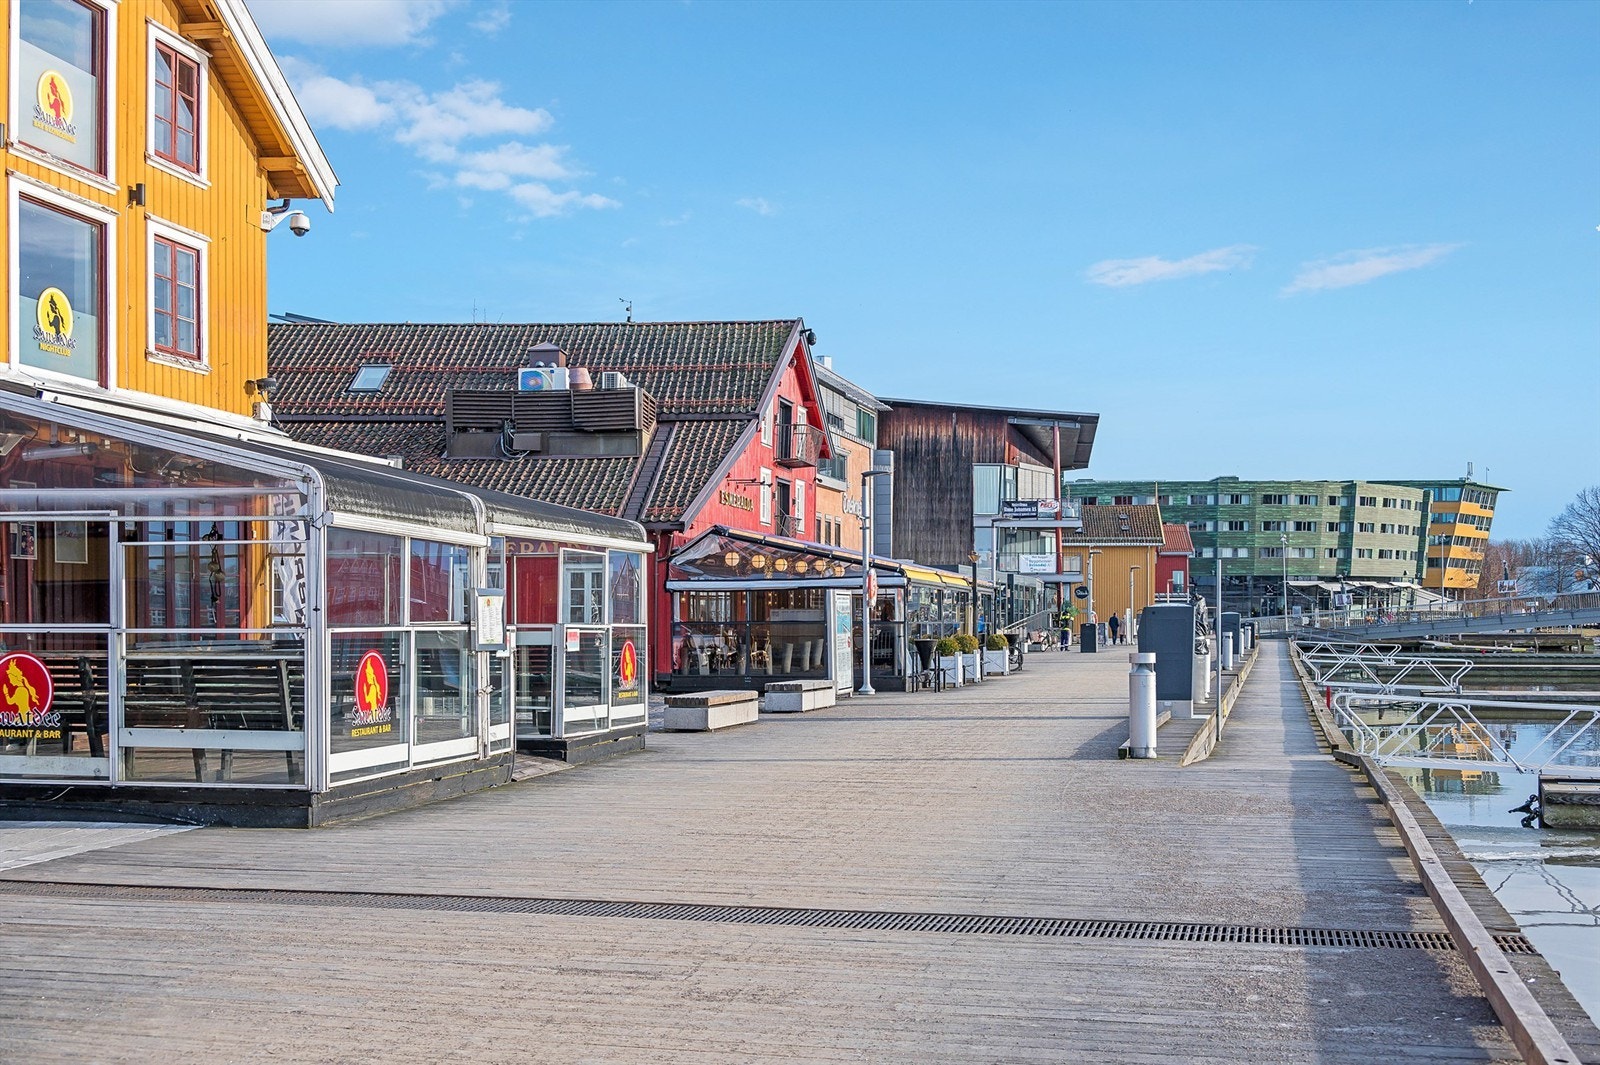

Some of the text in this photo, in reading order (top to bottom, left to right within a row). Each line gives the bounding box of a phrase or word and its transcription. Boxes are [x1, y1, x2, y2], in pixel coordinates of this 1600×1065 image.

[39, 342, 72, 358] NIGHTCLUB
[35, 730, 42, 738] &
[43, 730, 61, 739] BAR
[352, 726, 378, 737] RESTAURANT
[383, 724, 392, 732] BAR
